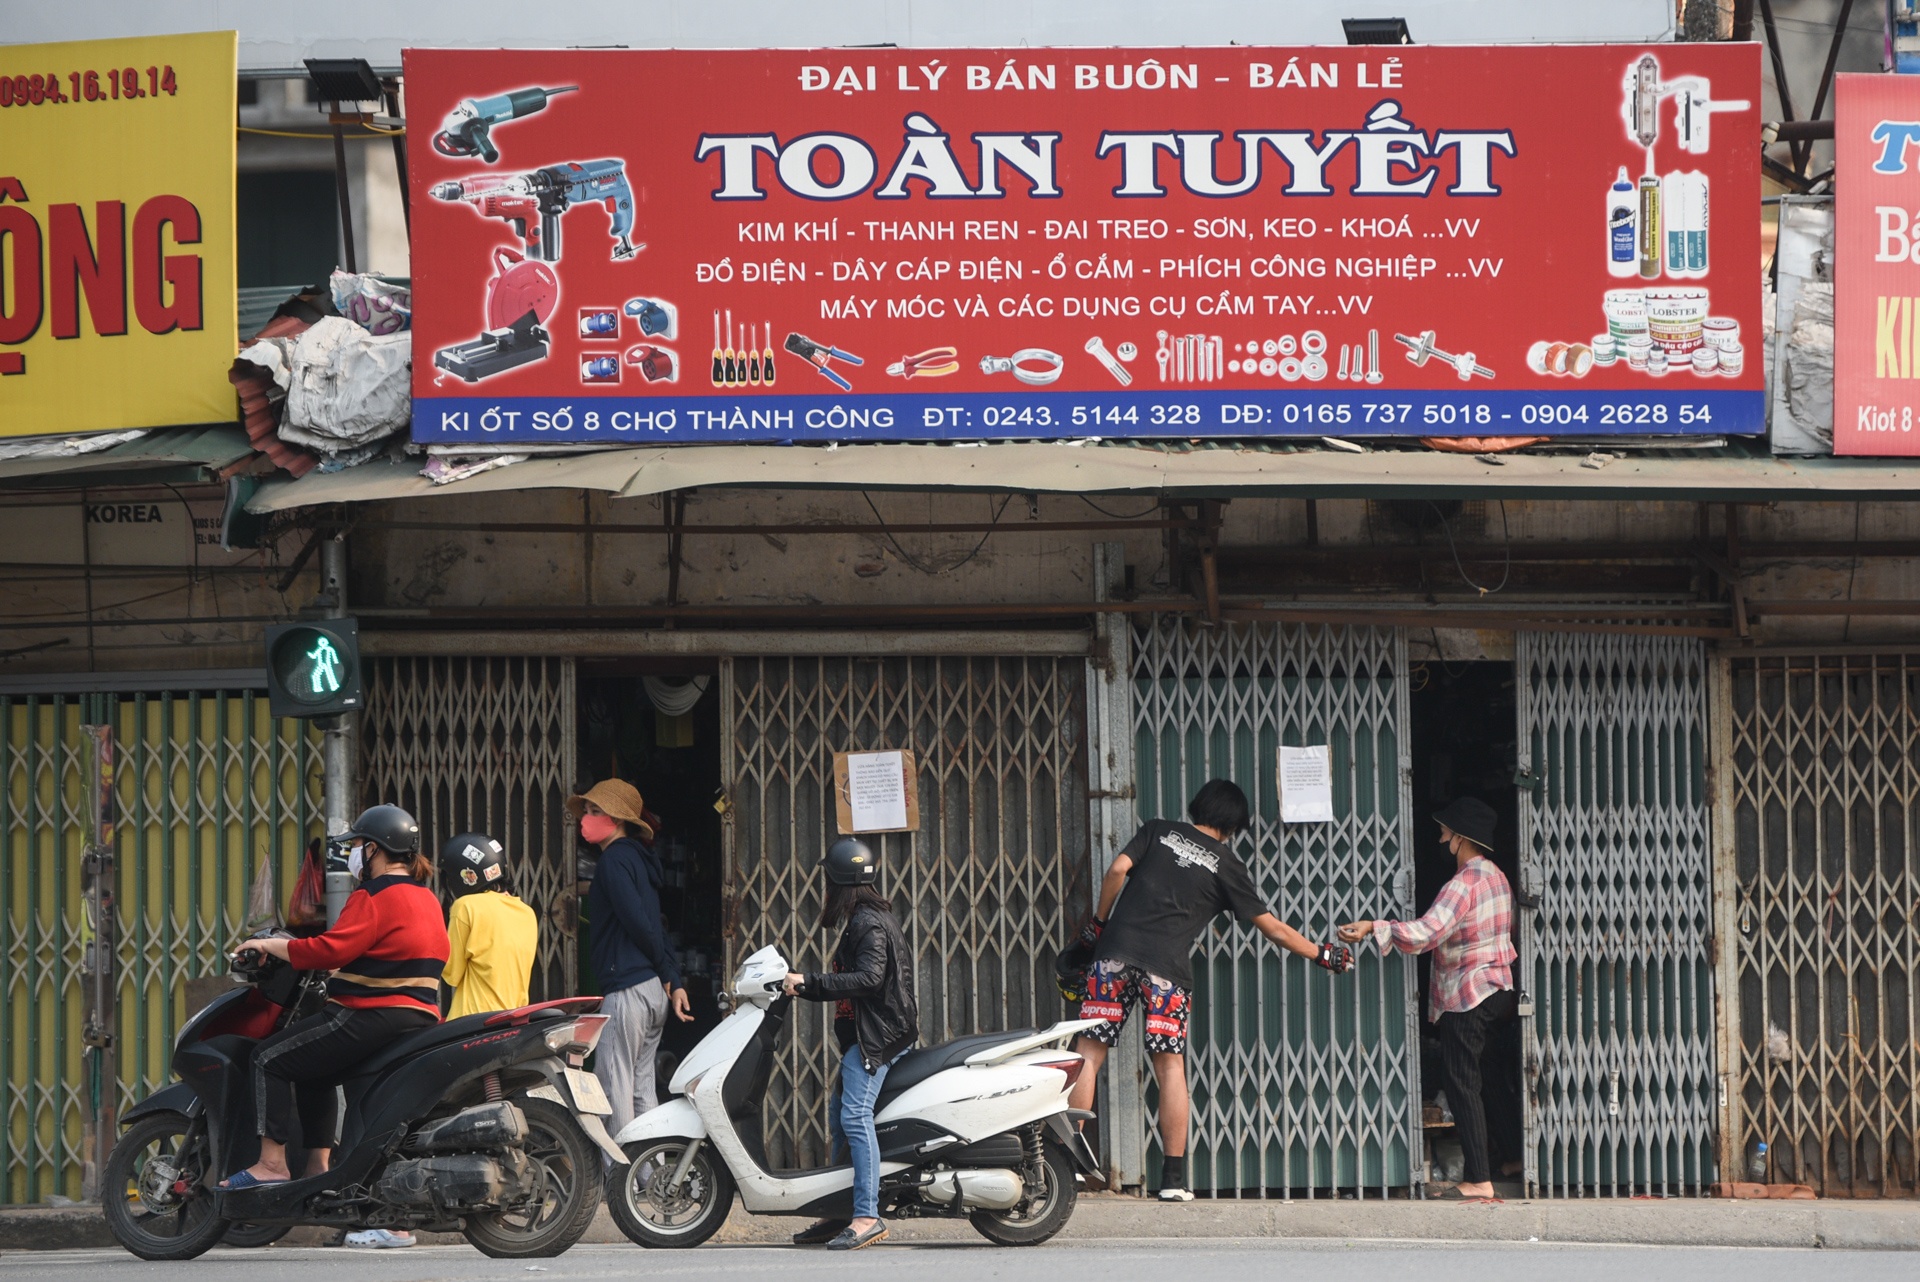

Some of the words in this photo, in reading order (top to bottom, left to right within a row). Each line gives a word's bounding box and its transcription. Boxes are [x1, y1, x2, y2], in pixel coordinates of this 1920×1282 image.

[0, 65, 177, 107] 0984.16.19.14
[797, 66, 876, 95] ĐẠI
[898, 60, 948, 91] LÝ
[966, 59, 1056, 90] BÁN
[1074, 58, 1198, 90] BUÔN
[1249, 57, 1338, 88] BÁN
[1357, 57, 1403, 88] LẺ
[696, 113, 1060, 199] TOÀN
[1098, 101, 1515, 196] TUYẾT
[1871, 119, 1920, 175] T
[738, 222, 785, 242] KIM
[794, 218, 838, 241] KHÍ
[863, 221, 955, 241] THANH
[964, 220, 1019, 240] REN
[1044, 220, 1088, 239] ĐAI
[1096, 219, 1169, 239] TREO
[1193, 217, 1254, 241] SƠN,
[1263, 218, 1317, 238] KEO
[1341, 214, 1414, 238] KHOÁ
[695, 257, 734, 283] ĐỒ
[741, 259, 806, 285] ĐIỆN
[833, 258, 887, 281] DÂY
[896, 257, 951, 281] CÁP
[958, 257, 1023, 283] ĐIỆN
[1047, 253, 1067, 280] Ổ
[1075, 253, 1133, 279] CẮM
[1160, 255, 1241, 278] PHÍCH
[1250, 254, 1326, 278] CÔNG
[1335, 254, 1437, 281] NGHIỆP
[820, 296, 878, 319] MÁY
[887, 295, 945, 318] MÓC
[953, 294, 990, 318] VÀ
[998, 294, 1054, 318] CÁC
[1063, 296, 1141, 320] DỤNG
[1149, 297, 1187, 319] CỤ
[1196, 291, 1254, 316] CẦM
[1652, 307, 1698, 316] LOBSTER
[441, 411, 469, 431] KI
[479, 405, 522, 432] ỐT
[531, 405, 574, 431] SỐ
[583, 411, 600, 431] 8
[610, 408, 677, 433] CHỢ
[686, 407, 794, 430] THÀNH
[805, 405, 894, 429] CÔNG
[922, 407, 972, 427] ĐT:
[983, 406, 1060, 427] 0243.
[1071, 405, 1140, 426] 5144
[1150, 405, 1201, 425] 328
[1220, 405, 1272, 424] DĐ:
[1283, 404, 1352, 424] 0165
[1361, 404, 1413, 424] 737
[1423, 404, 1492, 424] 5018
[1521, 404, 1590, 424] 0904
[1599, 404, 1669, 424] 2628
[1679, 404, 1713, 424] 54
[1857, 405, 1897, 432] Kiot
[1902, 406, 1913, 432] 8
[85, 504, 163, 523] KOREA
[1080, 1002, 1123, 1017] Supreme
